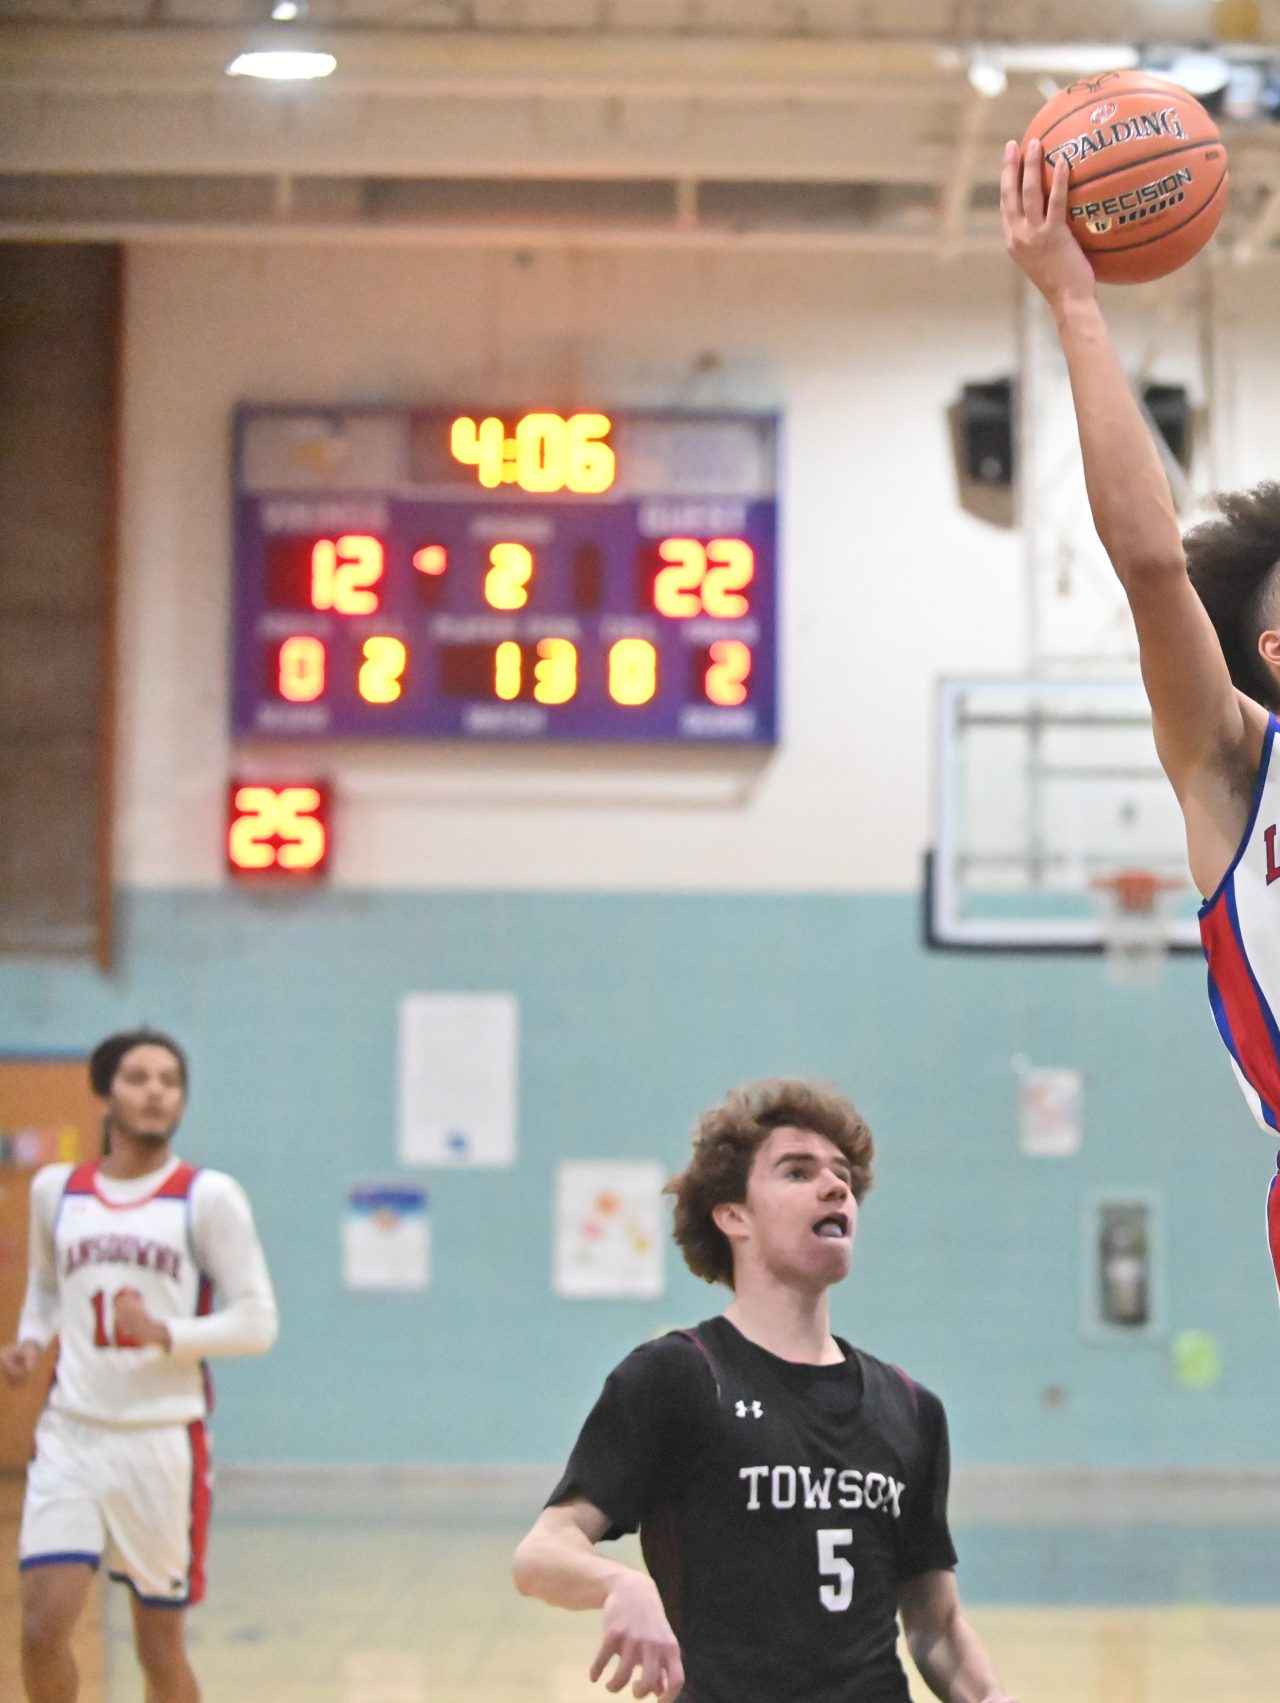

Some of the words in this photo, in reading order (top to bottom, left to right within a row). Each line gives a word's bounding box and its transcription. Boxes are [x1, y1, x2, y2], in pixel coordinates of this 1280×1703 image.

[1069, 168, 1193, 222] PRECISION
[449, 412, 617, 494] 4:06
[310, 534, 385, 616] 12
[483, 542, 534, 611] 2
[653, 537, 755, 619] 22
[278, 635, 326, 703] 0
[358, 635, 407, 704] 2
[608, 638, 657, 706] 0
[704, 638, 753, 707] 2
[229, 787, 326, 870] 25
[739, 1465, 906, 1518] TOWSON
[816, 1528, 855, 1612] 5
